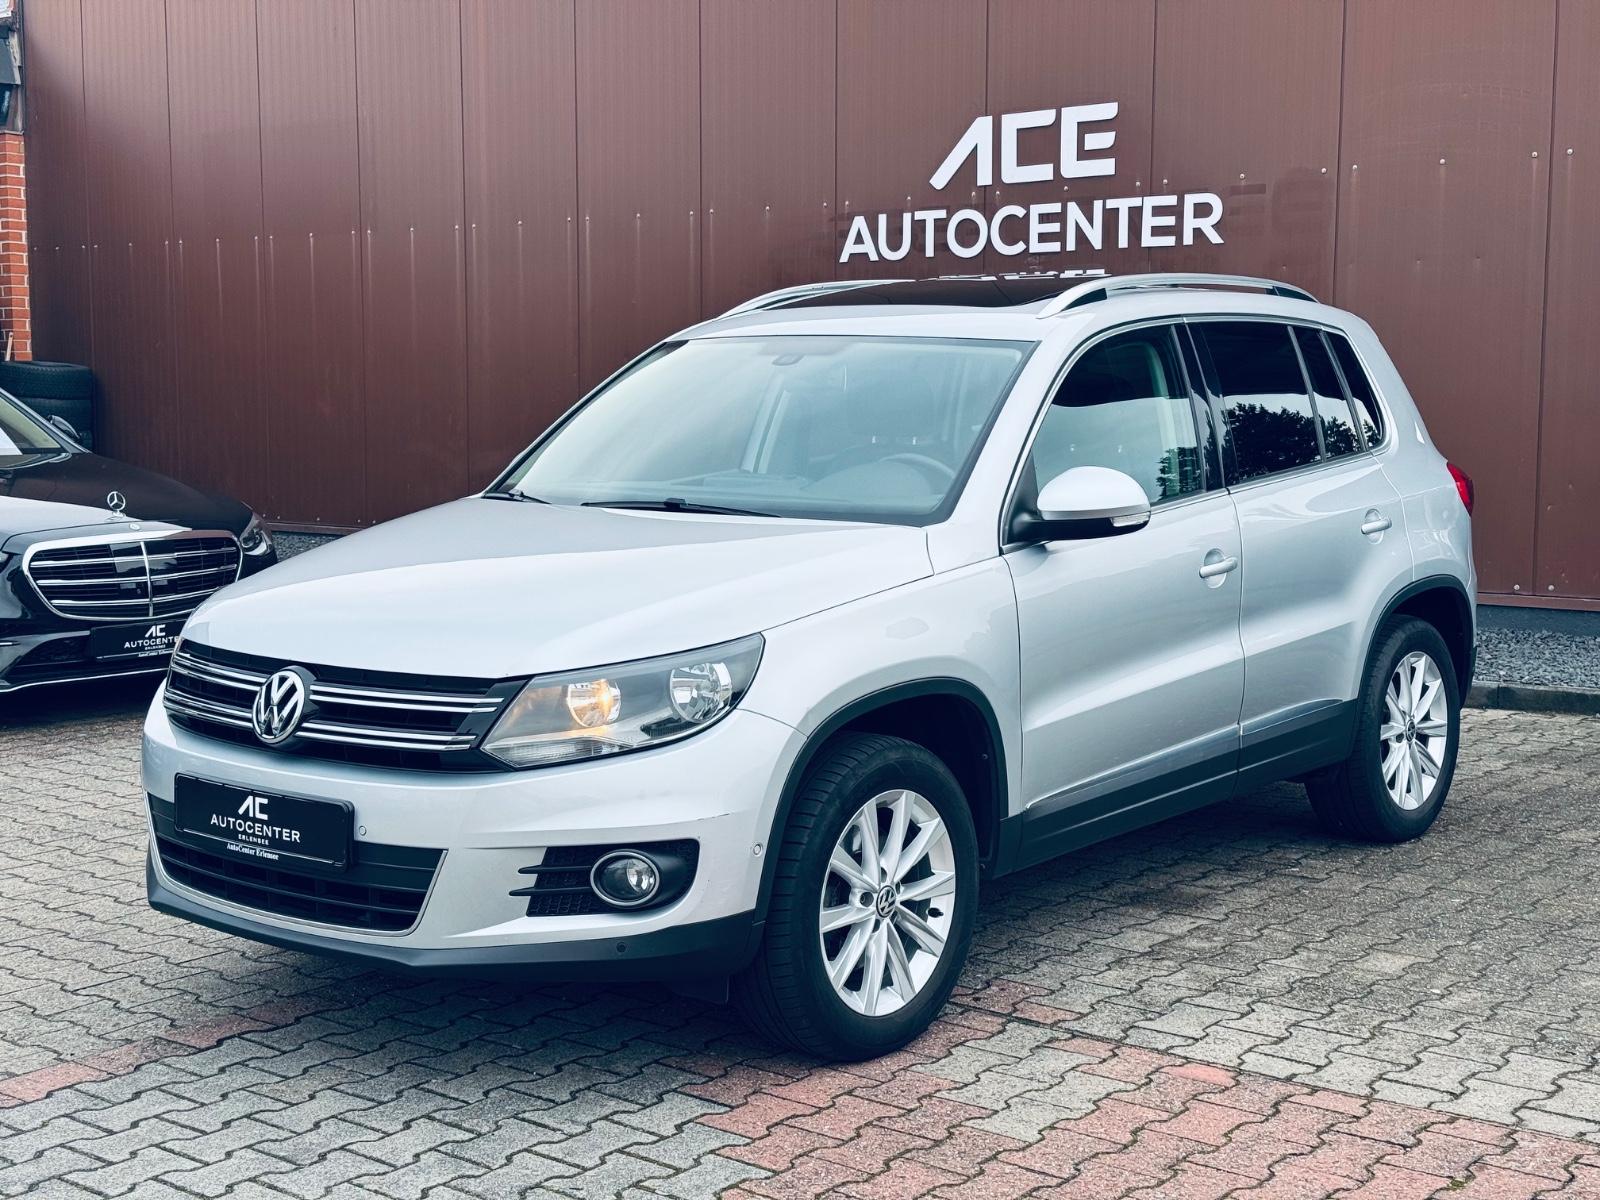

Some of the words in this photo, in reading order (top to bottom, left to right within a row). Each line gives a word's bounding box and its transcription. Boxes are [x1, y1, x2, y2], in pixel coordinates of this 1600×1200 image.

[929, 102, 1119, 190] ACE
[839, 192, 1224, 264] AUTOCENTER
[123, 635, 180, 649] AUTOCENTE
[238, 795, 269, 820] AC
[210, 814, 300, 843] AUTOCENTER
